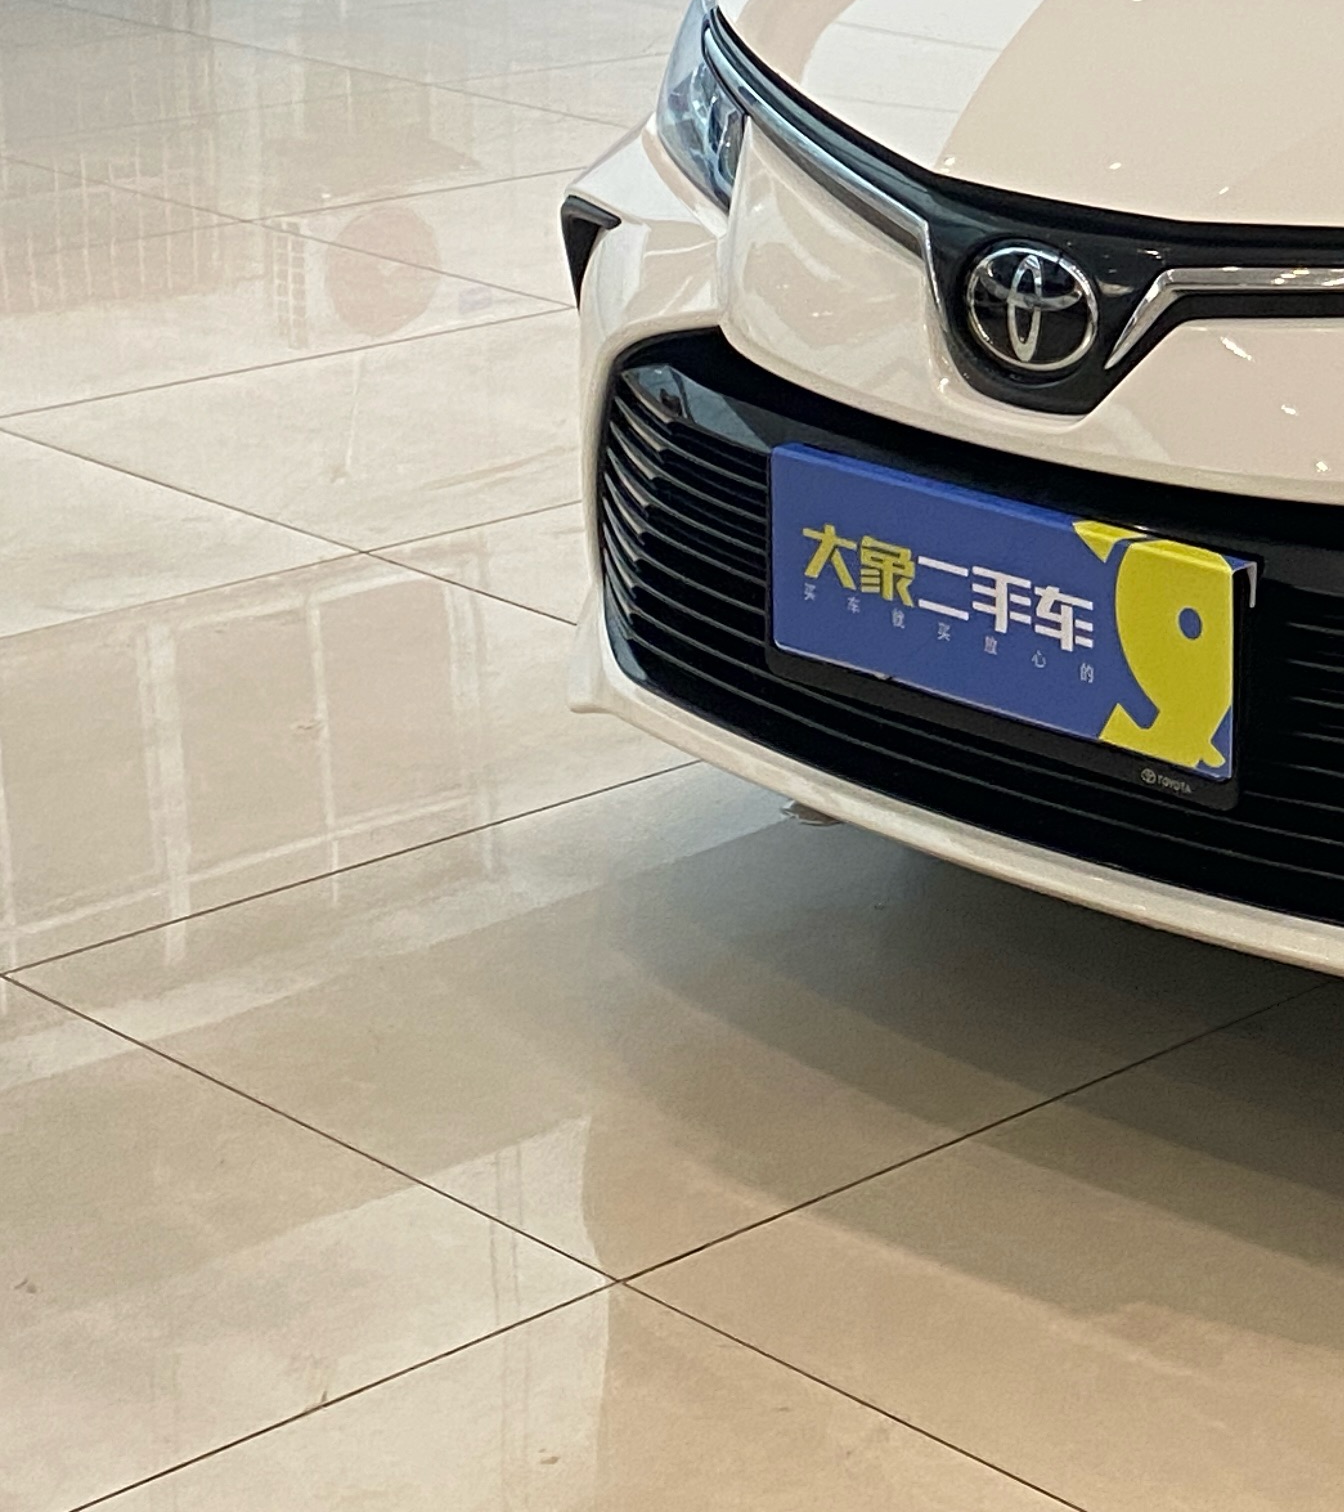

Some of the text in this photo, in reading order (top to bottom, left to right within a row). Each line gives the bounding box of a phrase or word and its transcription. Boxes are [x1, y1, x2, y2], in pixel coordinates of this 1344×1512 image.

[802, 523, 1095, 652] 大象二手车
